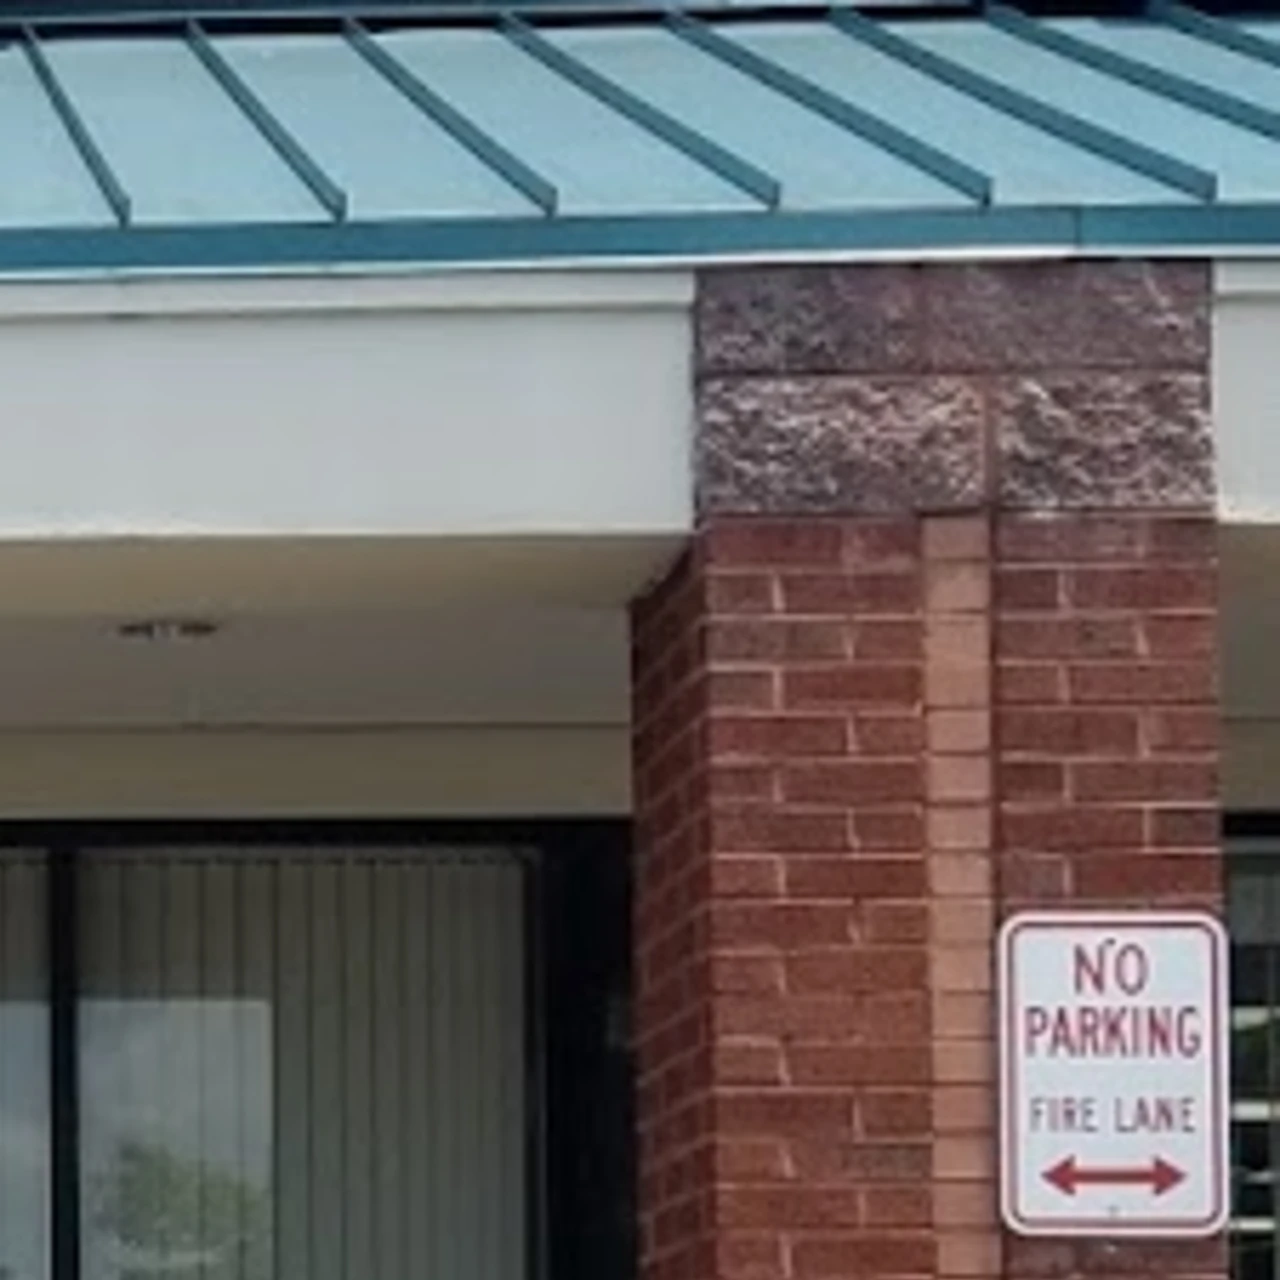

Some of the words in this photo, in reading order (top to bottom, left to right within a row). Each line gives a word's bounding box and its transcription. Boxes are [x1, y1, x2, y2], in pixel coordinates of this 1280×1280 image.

[1073, 943, 1150, 996] NO
[1025, 1006, 1202, 1058] PARKING
[1030, 1098, 1099, 1133] FIRE
[1114, 1098, 1196, 1133] LANE
